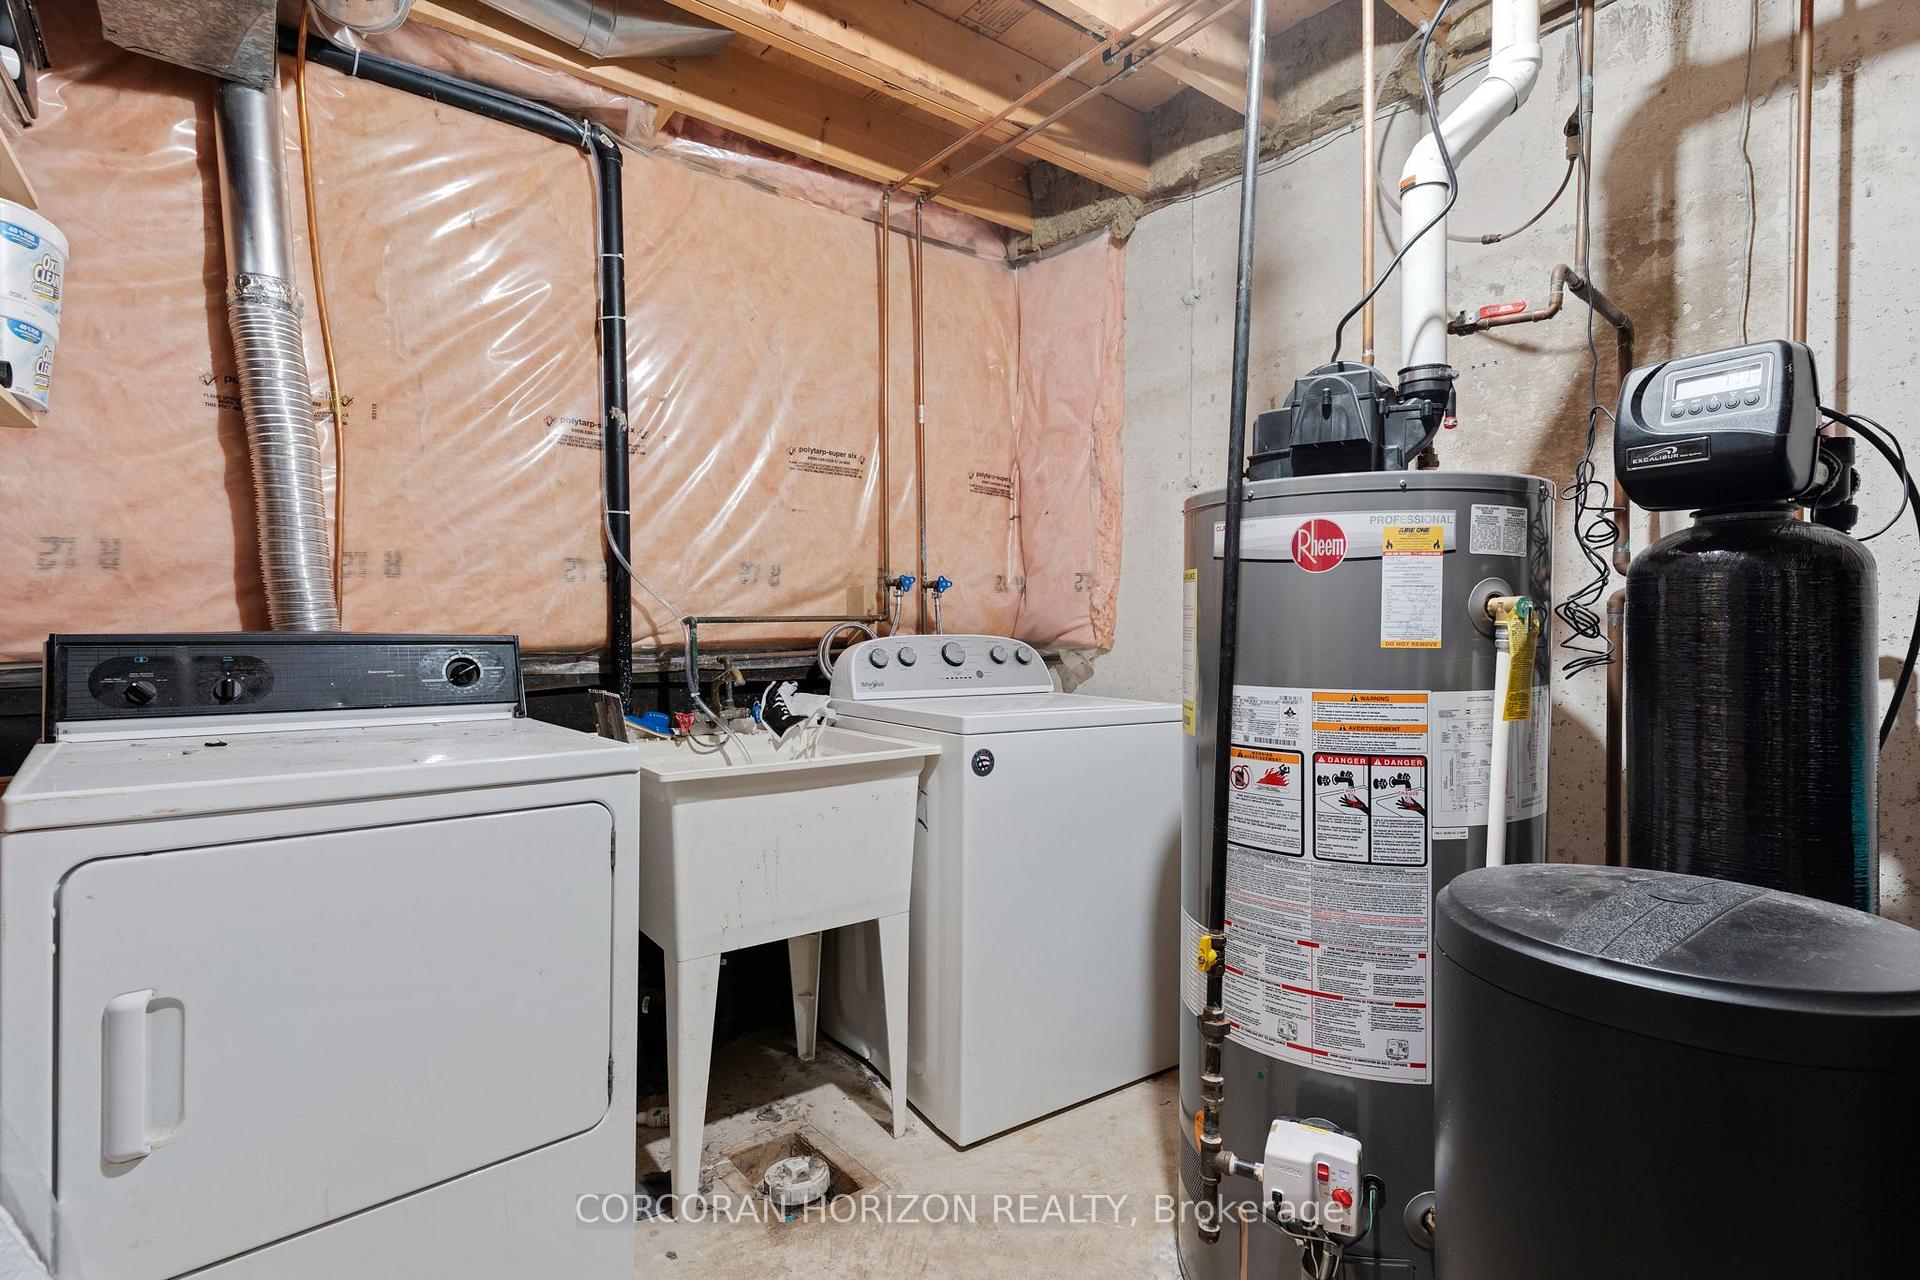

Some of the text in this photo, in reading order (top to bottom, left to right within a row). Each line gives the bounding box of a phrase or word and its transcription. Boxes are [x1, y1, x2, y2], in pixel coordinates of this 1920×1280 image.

[798, 446, 847, 458] polytarp-super
[1632, 453, 1679, 465] EXCALIBUR
[1369, 514, 1454, 525] PROFESSIONAL
[1297, 519, 1344, 564] Rheem
[1327, 757, 1366, 765] DANGER
